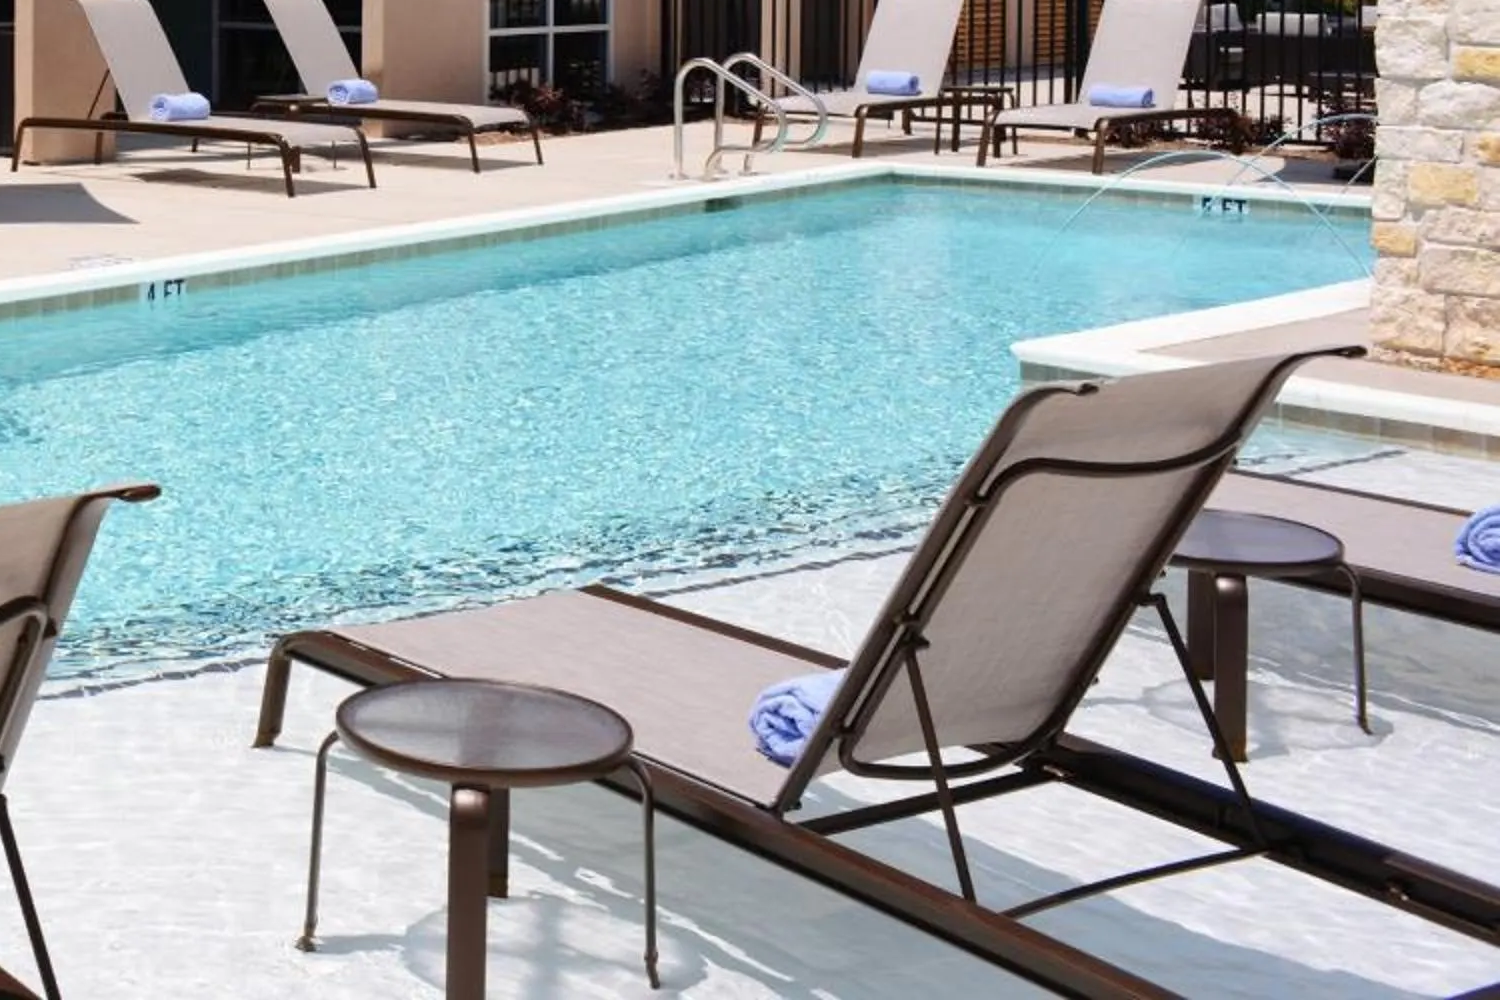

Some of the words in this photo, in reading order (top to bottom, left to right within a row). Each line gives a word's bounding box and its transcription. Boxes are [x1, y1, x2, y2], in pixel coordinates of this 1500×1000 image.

[1222, 197, 1247, 212] FT
[147, 282, 155, 300] 4
[164, 278, 185, 298] FT
